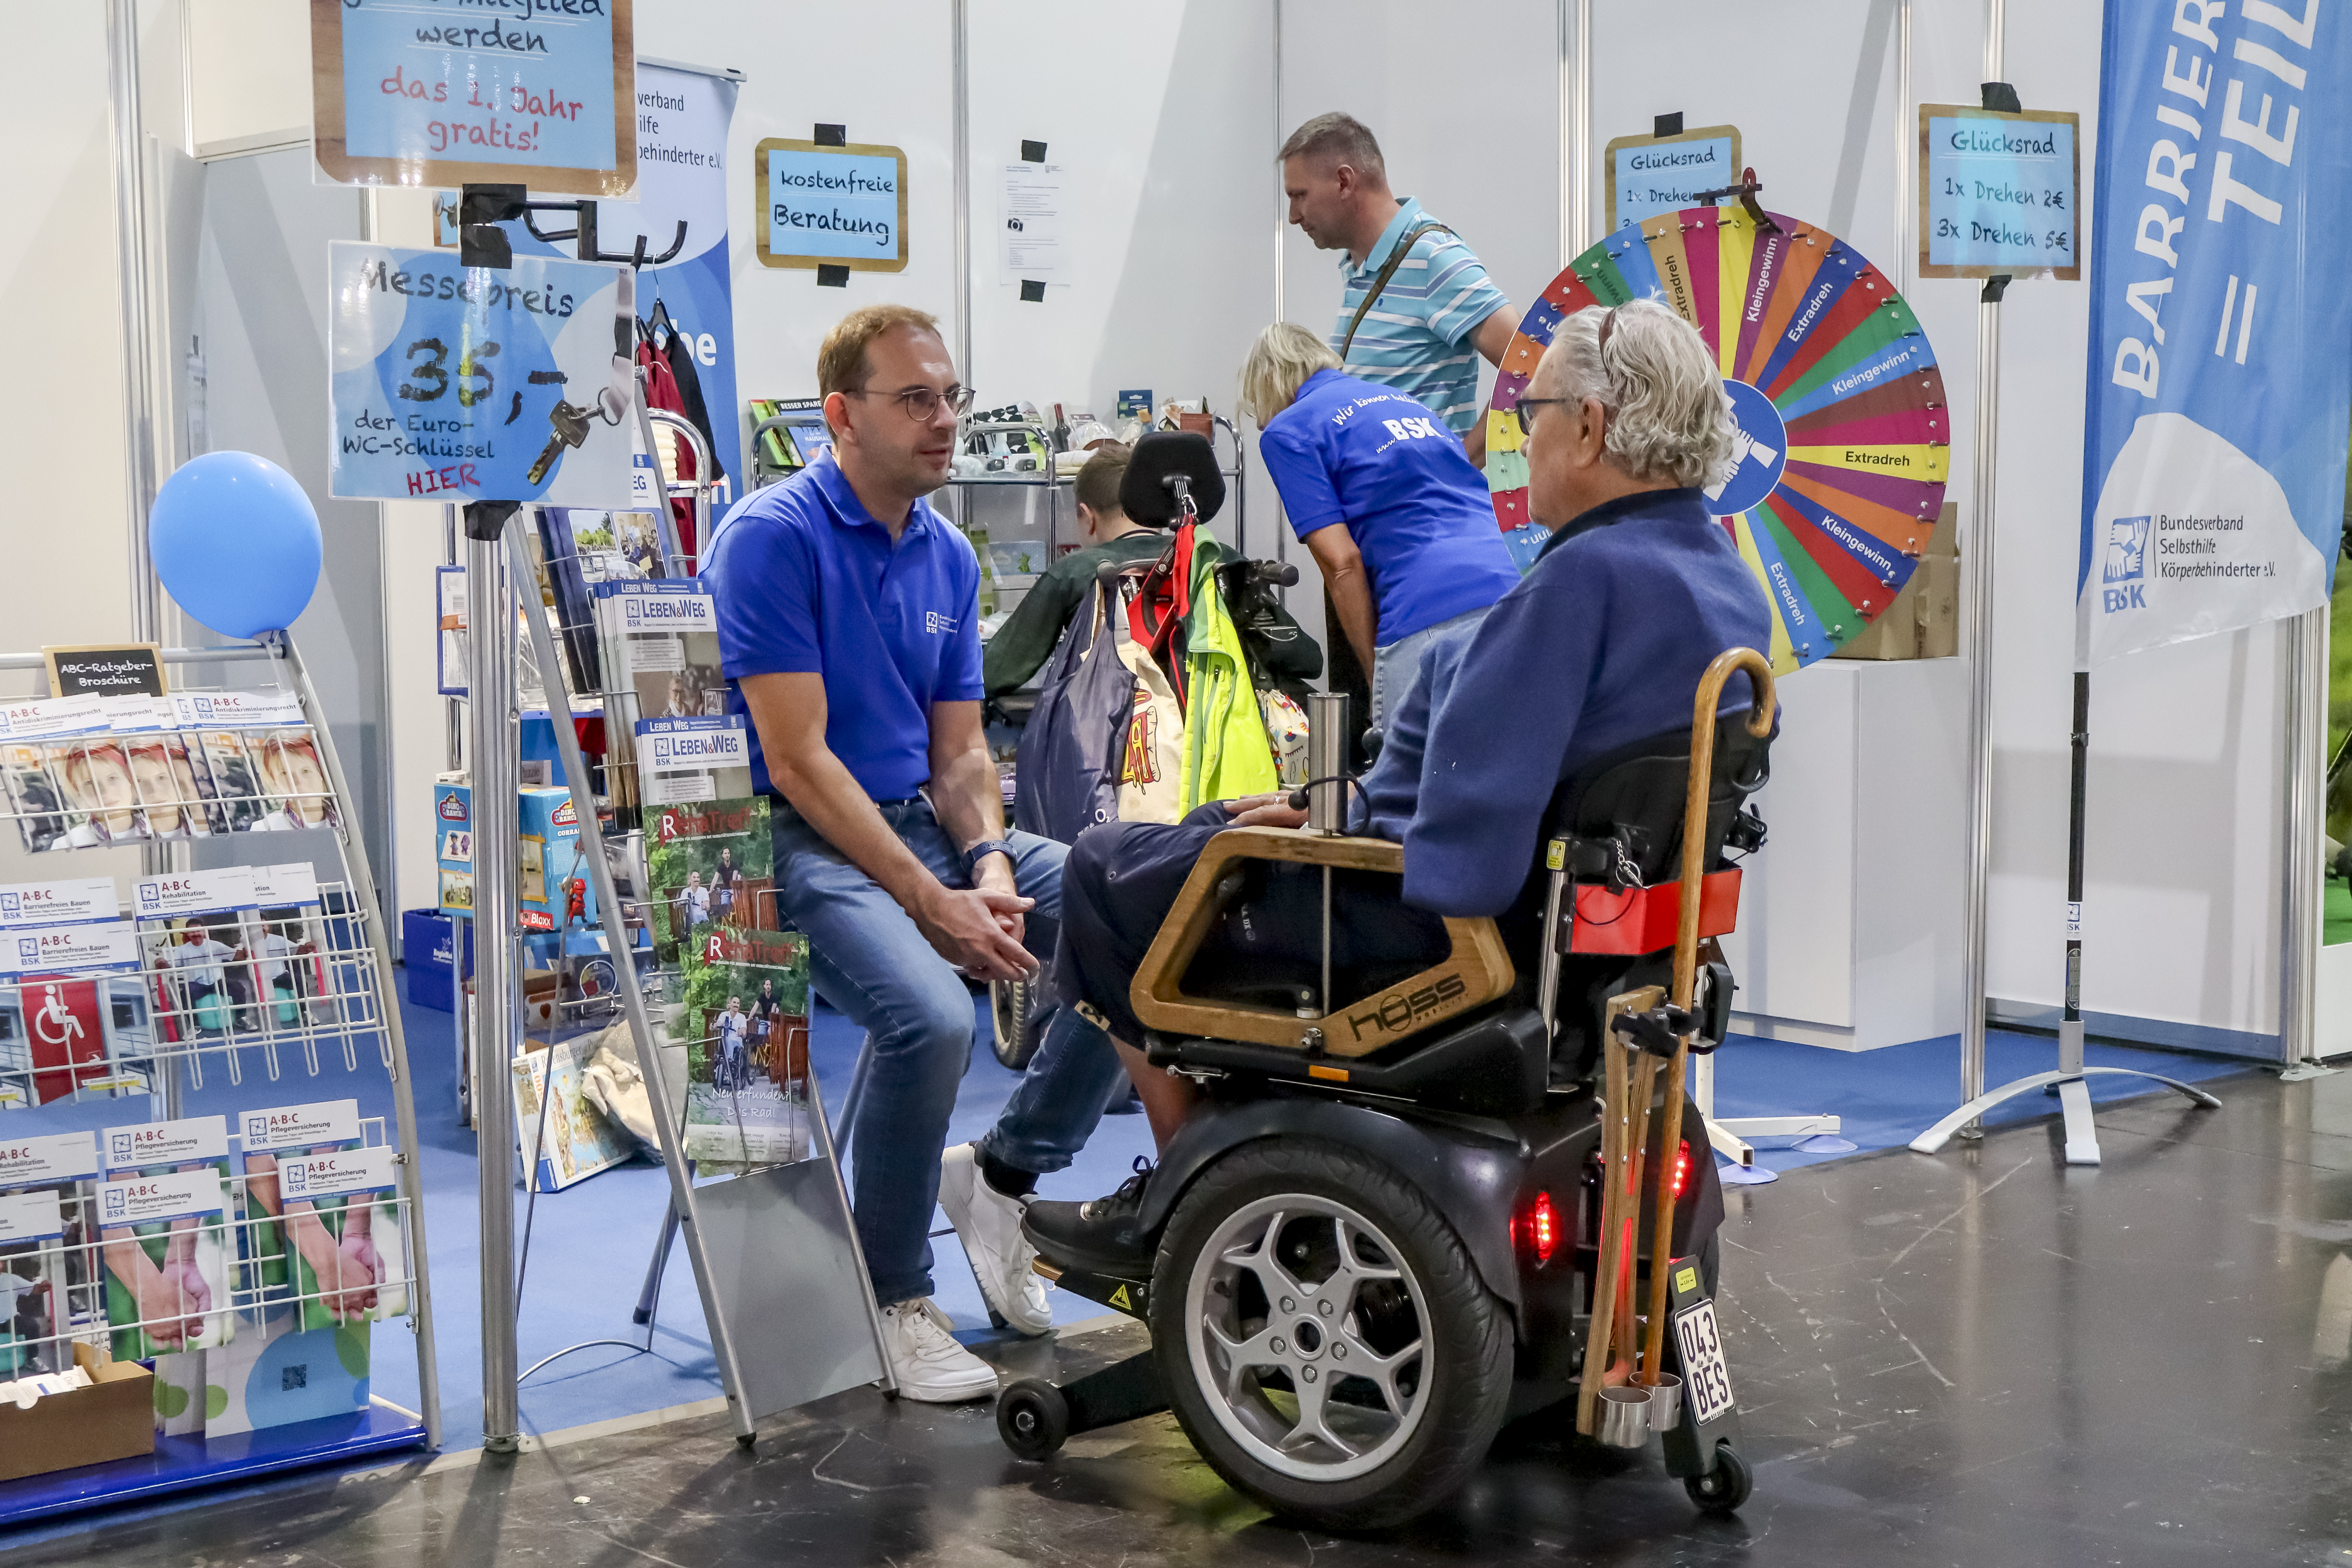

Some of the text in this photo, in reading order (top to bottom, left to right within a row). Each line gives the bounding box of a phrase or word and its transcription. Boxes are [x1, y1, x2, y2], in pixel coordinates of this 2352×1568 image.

[416, 19, 547, 53] werden
[381, 65, 583, 121] das 1. Jahr
[638, 91, 684, 111] verband
[2208, 0, 2319, 225] TEIL
[640, 115, 659, 134] ilfe
[427, 117, 538, 152] gratis!
[1951, 130, 2056, 154] Glücksrad
[1631, 145, 1715, 170] Glücksrad
[781, 170, 894, 194] kostenfreie
[1946, 177, 2064, 210] 1x Drehen 2€
[2112, 0, 2225, 399] BARRIER
[774, 204, 889, 246] Beratung
[1937, 218, 2069, 251] 3x Drehen 5€
[361, 257, 573, 318] Messepreis
[1747, 237, 1778, 322] Kleingewinn
[1787, 282, 1833, 342] Extradreh
[1832, 350, 1910, 395] Kleingewinn
[1332, 405, 1354, 425] Wir
[1353, 395, 1390, 408] können
[354, 409, 474, 434] der Euro-
[343, 436, 495, 458] WC-Schlüssel
[1846, 451, 1910, 467] Extradreh
[406, 463, 480, 495] HIER
[2160, 515, 2243, 531] Bundesverband
[1821, 515, 1891, 571] Kleingewinn
[2159, 538, 2216, 554] Selbsthilfe
[2161, 562, 2260, 581] Körperbehinderter
[1770, 562, 1806, 626] Extradreh
[2103, 584, 2146, 614] BSK
[61, 660, 153, 674] ABC-Ratgeber-
[78, 675, 142, 687] Broschüre
[13, 708, 101, 725] Antidiskriminierungsrecht
[106, 709, 152, 718] nierungsrecht
[215, 704, 296, 713] Antidiskriminierungsrecht
[162, 890, 206, 899] Rehabilitation
[4, 911, 22, 920] BSK
[24, 902, 69, 910] Barrierefreies
[143, 902, 161, 910] BSK
[531, 913, 550, 926] Bloxx
[42, 947, 87, 955] Barrierefreies
[21, 957, 40, 965] BSK
[542, 1046, 581, 1068] Rensburger
[737, 1087, 790, 1103] erfunden?
[727, 1106, 776, 1118] Ds Rad!
[271, 1121, 330, 1133] Pflegeversicherung
[136, 1139, 197, 1150] Pflegeversicherung
[250, 1137, 268, 1145] BSK
[114, 1154, 132, 1163] BSK
[309, 1168, 366, 1180] Pflegeversicherung
[289, 1184, 306, 1193] BSK
[129, 1192, 191, 1205] Pflegeversicherung
[107, 1209, 126, 1218] BSK
[1682, 1311, 1717, 1363] 043
[1693, 1361, 1728, 1415] BES
